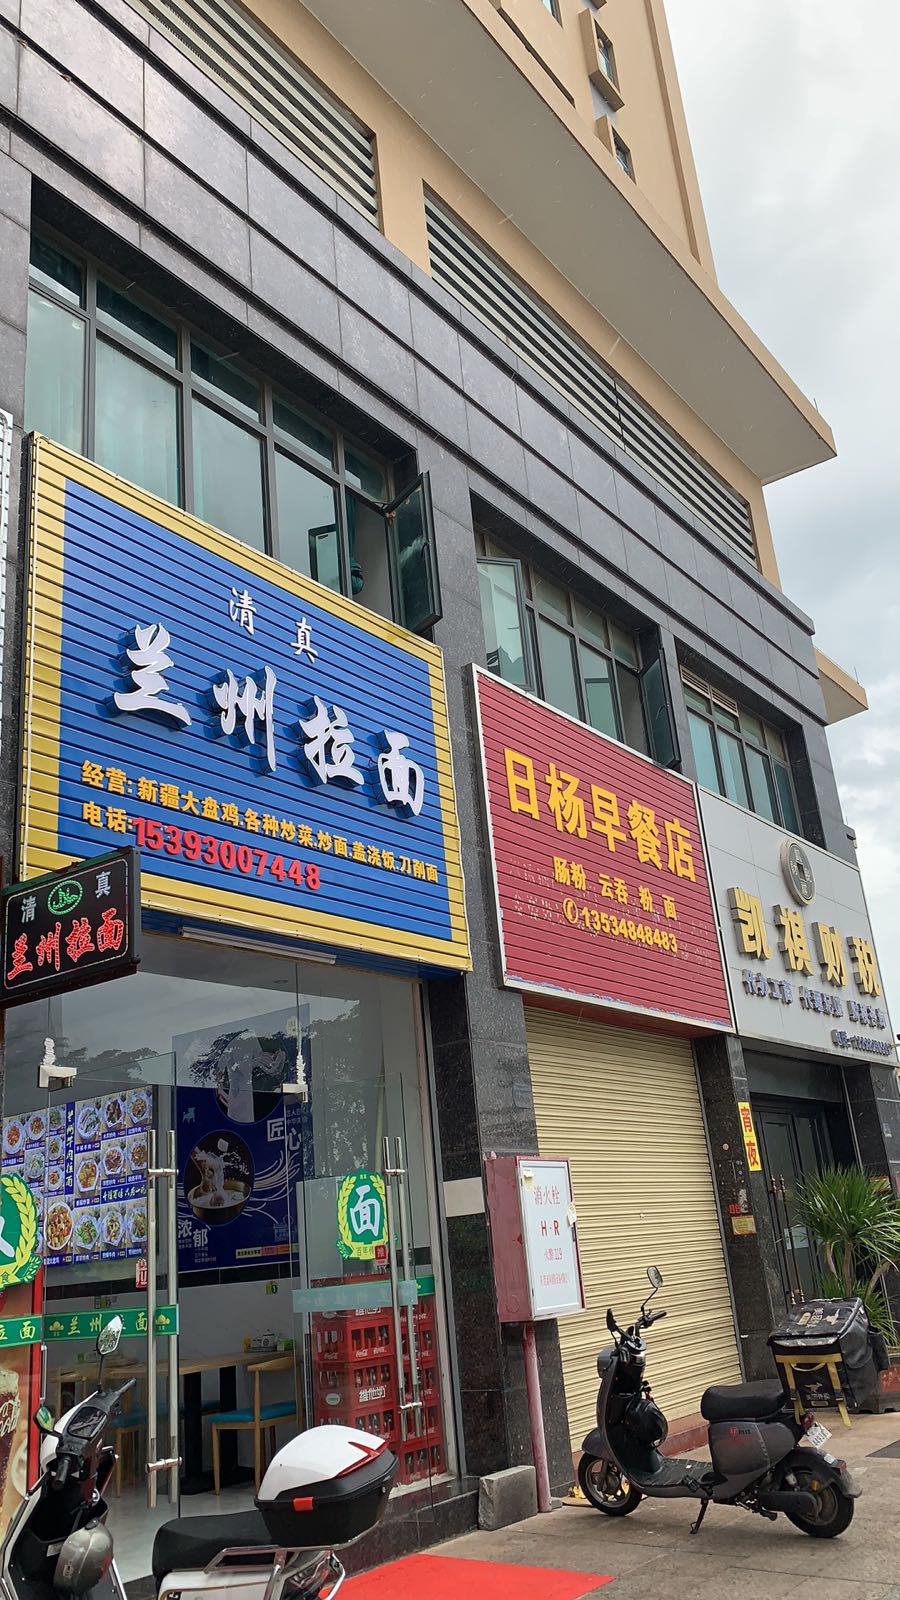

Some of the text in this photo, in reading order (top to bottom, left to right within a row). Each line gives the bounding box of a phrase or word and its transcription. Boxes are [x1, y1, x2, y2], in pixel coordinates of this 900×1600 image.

[228, 587, 319, 663] 清真
[113, 622, 425, 816] 兰州拉面
[504, 748, 696, 882] 日杨早餐店
[553, 856, 677, 921] 肠粉 云吞 粉 面
[7, 907, 125, 981] 兰州拉面
[582, 906, 678, 953] 13534848483
[350, 1185, 380, 1237] 面
[533, 1185, 561, 1206] 消火栓
[178, 1219, 209, 1247] 浓郁
[68, 1312, 148, 1336] 兰州面
